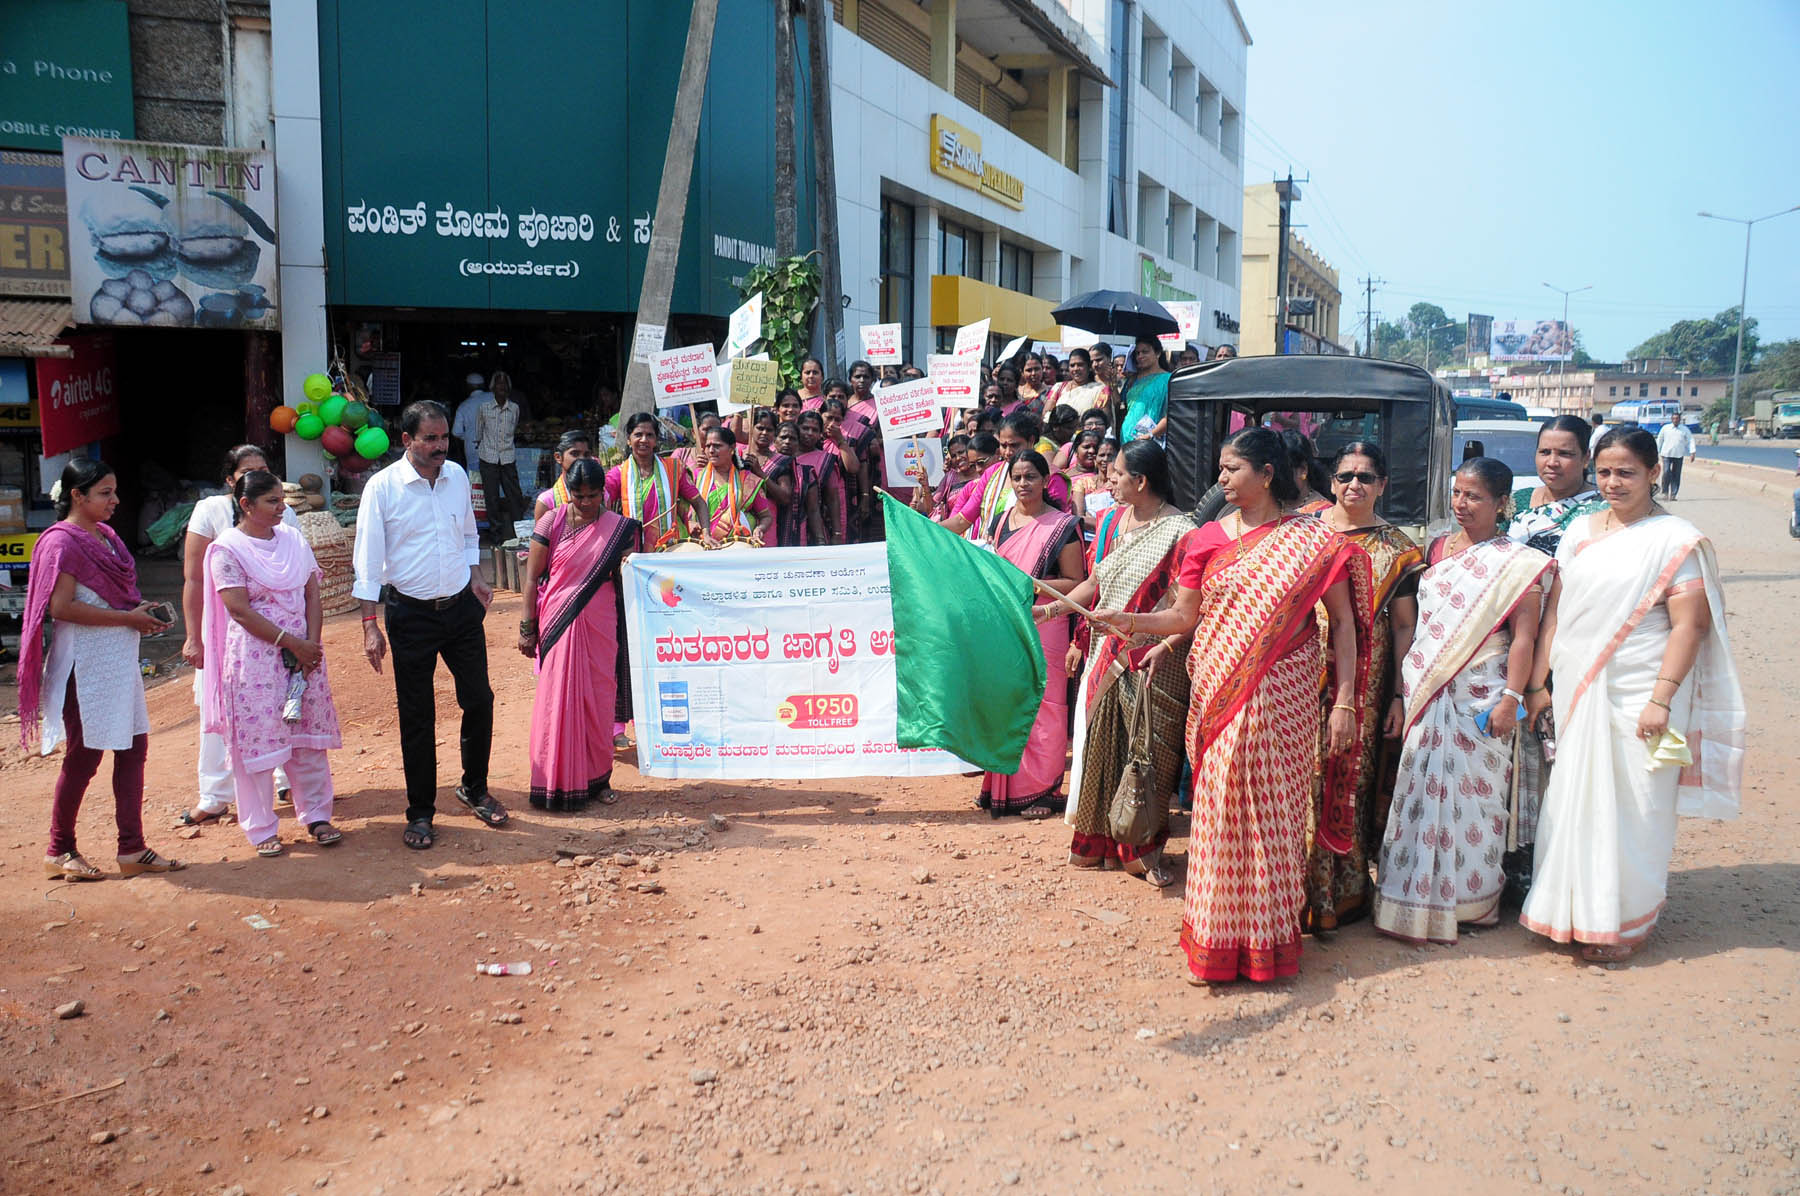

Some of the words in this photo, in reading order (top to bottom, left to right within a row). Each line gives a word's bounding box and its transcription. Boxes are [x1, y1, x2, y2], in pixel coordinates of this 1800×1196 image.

[34, 60, 113, 83] Phone
[0, 119, 50, 136] OBILE
[55, 124, 121, 140] CORNER
[75, 152, 264, 191] CANTIN
[347, 198, 427, 235] ಪಂಡಿತ್
[435, 202, 510, 239] ತೋಮ
[518, 206, 595, 248] ಪೂಜಾರಿ
[606, 216, 622, 243] &
[633, 211, 655, 244] ಸ
[714, 233, 738, 260] PANDIT
[738, 239, 760, 265] THOMA
[459, 258, 580, 279] (ಆಯುರ್ವೇದ)
[63, 372, 94, 407] airtel
[95, 367, 113, 395] 4G
[0, 406, 32, 421] 4G
[754, 569, 780, 582] ಭಾರತ
[830, 566, 866, 578] ಆಯೋಗ
[752, 588, 783, 600] ಹಾಗೂ
[789, 587, 826, 599] SVEEP
[656, 623, 770, 662] ಮತದಾರರ
[783, 623, 857, 674] ಜಾಗೃತಿ
[803, 697, 854, 716] 1950
[807, 718, 829, 727] TOLL
[830, 717, 853, 726] FREE
[717, 744, 769, 757] ಮತದಾರ
[775, 742, 855, 757] ಮತದಾನದಿಂದ
